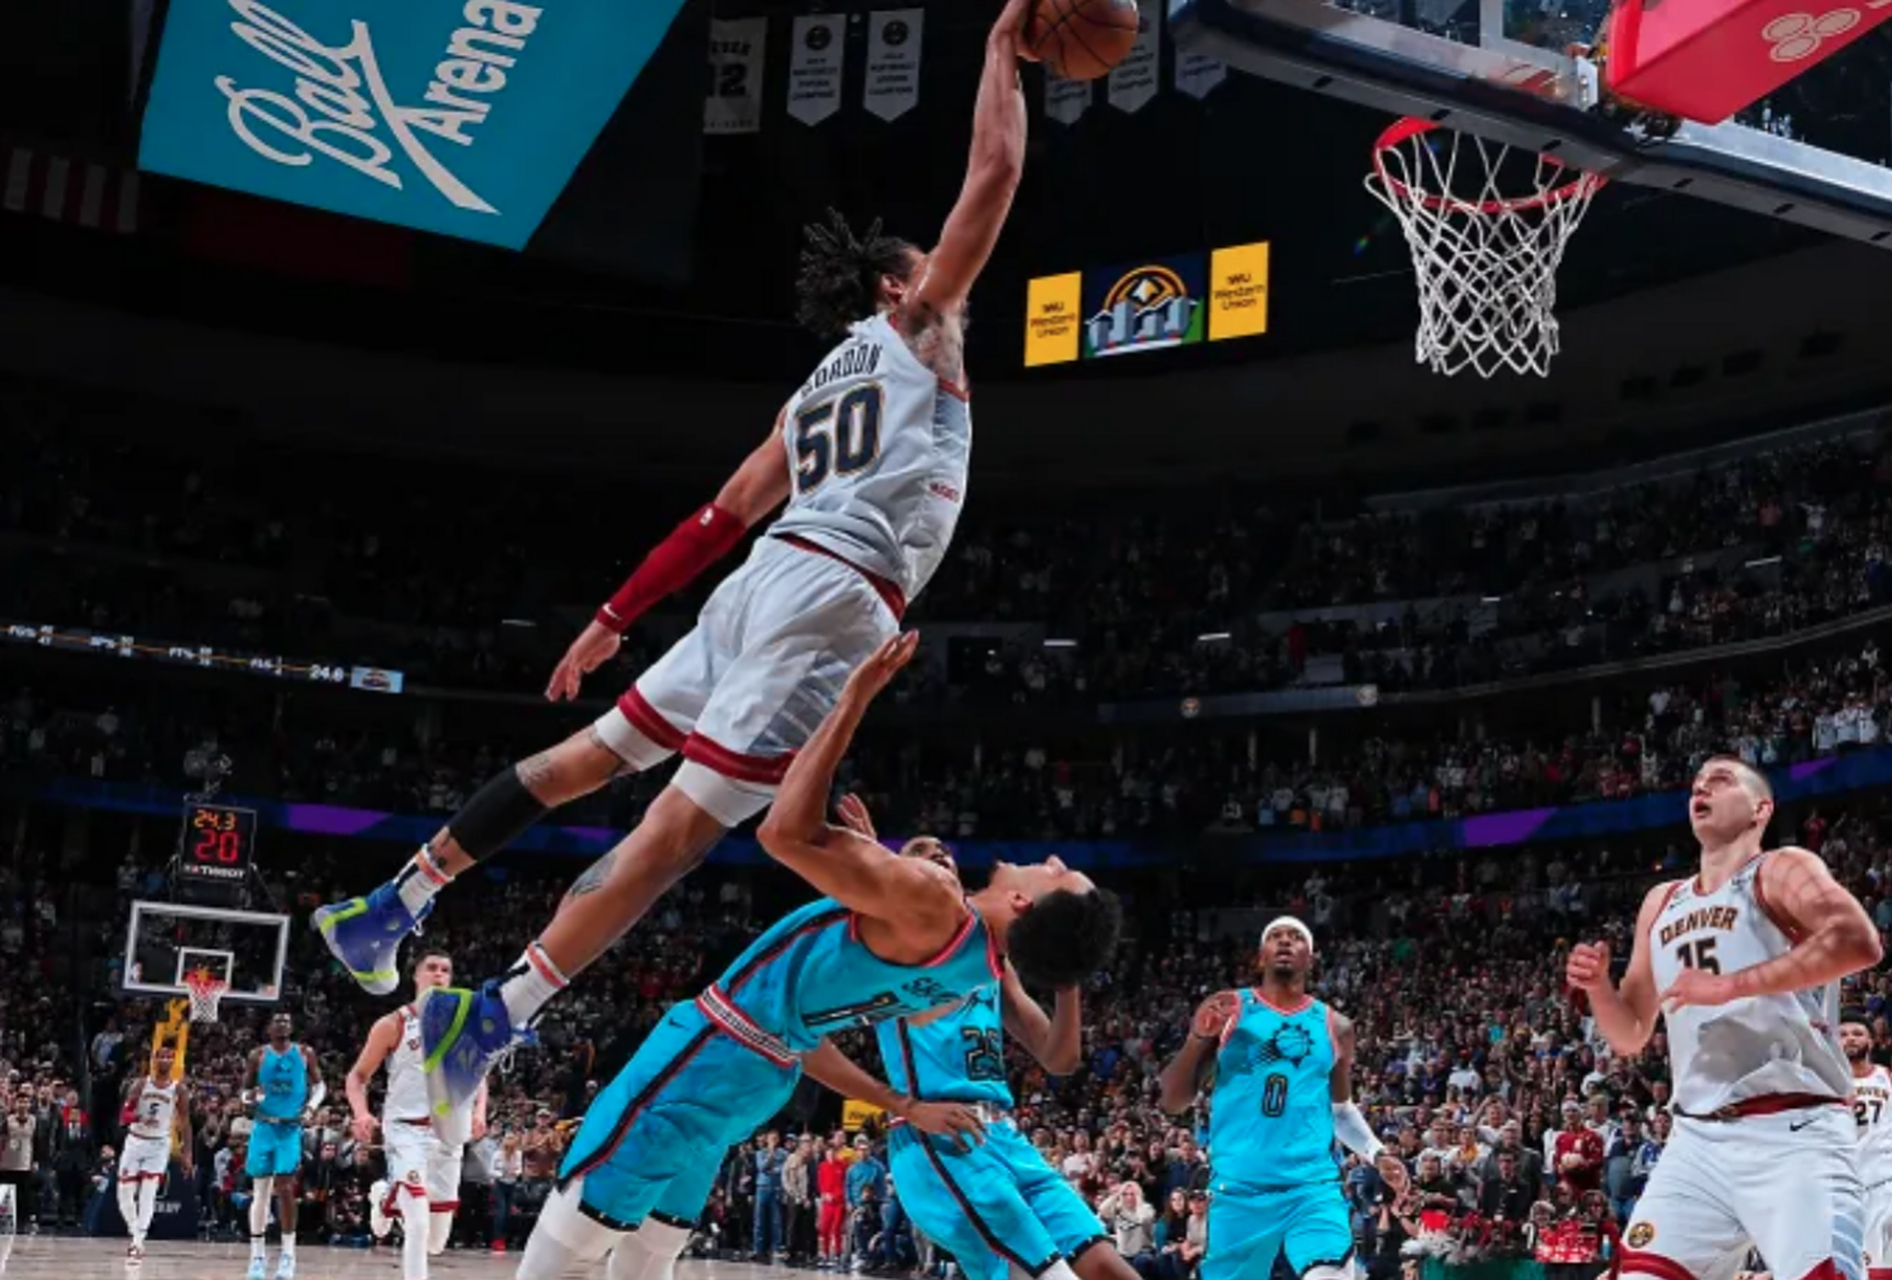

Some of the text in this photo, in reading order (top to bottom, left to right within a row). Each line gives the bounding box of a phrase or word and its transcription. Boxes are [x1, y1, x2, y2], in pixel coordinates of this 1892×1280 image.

[393, 0, 543, 147] Arena
[796, 380, 885, 494] 50
[193, 808, 237, 831] 24.3
[194, 828, 239, 862] 20
[1660, 905, 1738, 947] DENVER
[1676, 936, 1721, 975] 15
[1261, 1072, 1288, 1118] 0
[1853, 1100, 1883, 1127] 27
